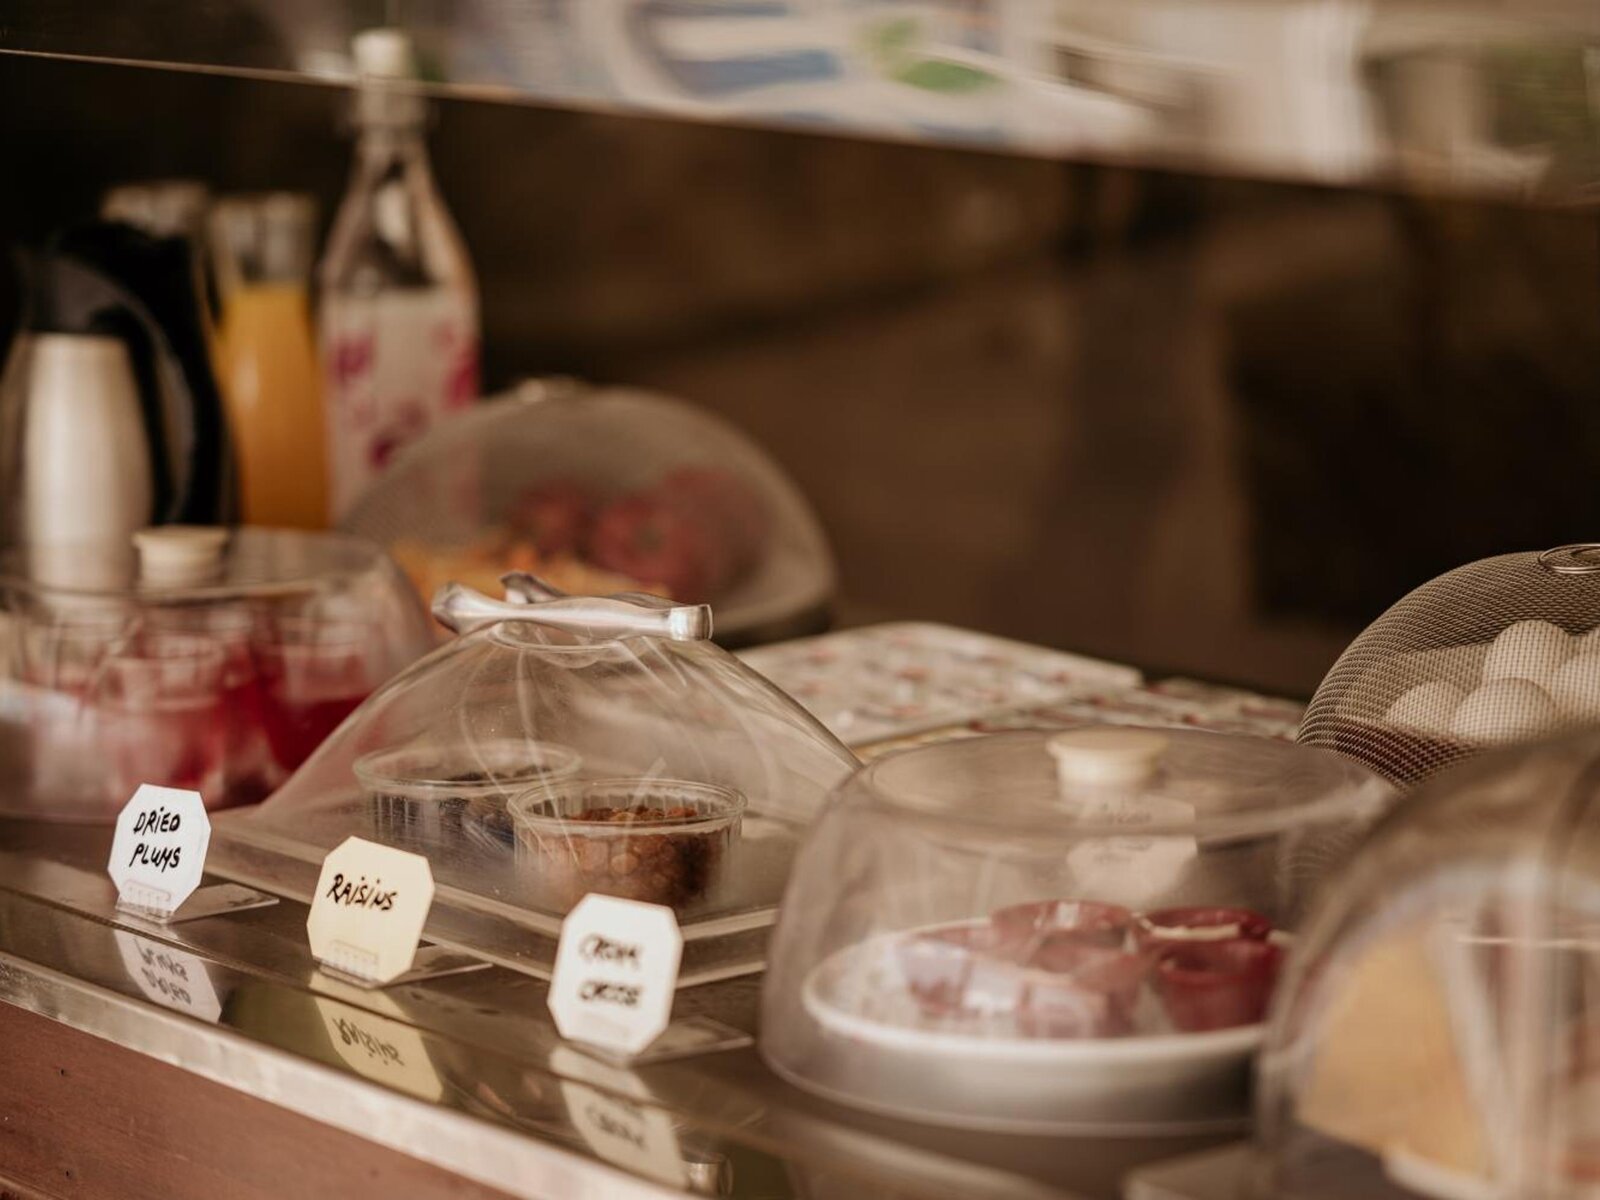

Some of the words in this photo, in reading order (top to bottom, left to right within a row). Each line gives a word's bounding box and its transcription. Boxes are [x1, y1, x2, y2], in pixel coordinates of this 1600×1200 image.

[133, 806, 181, 836] DRIED
[129, 843, 181, 873] PLUMS
[326, 873, 398, 911] RAISINS
